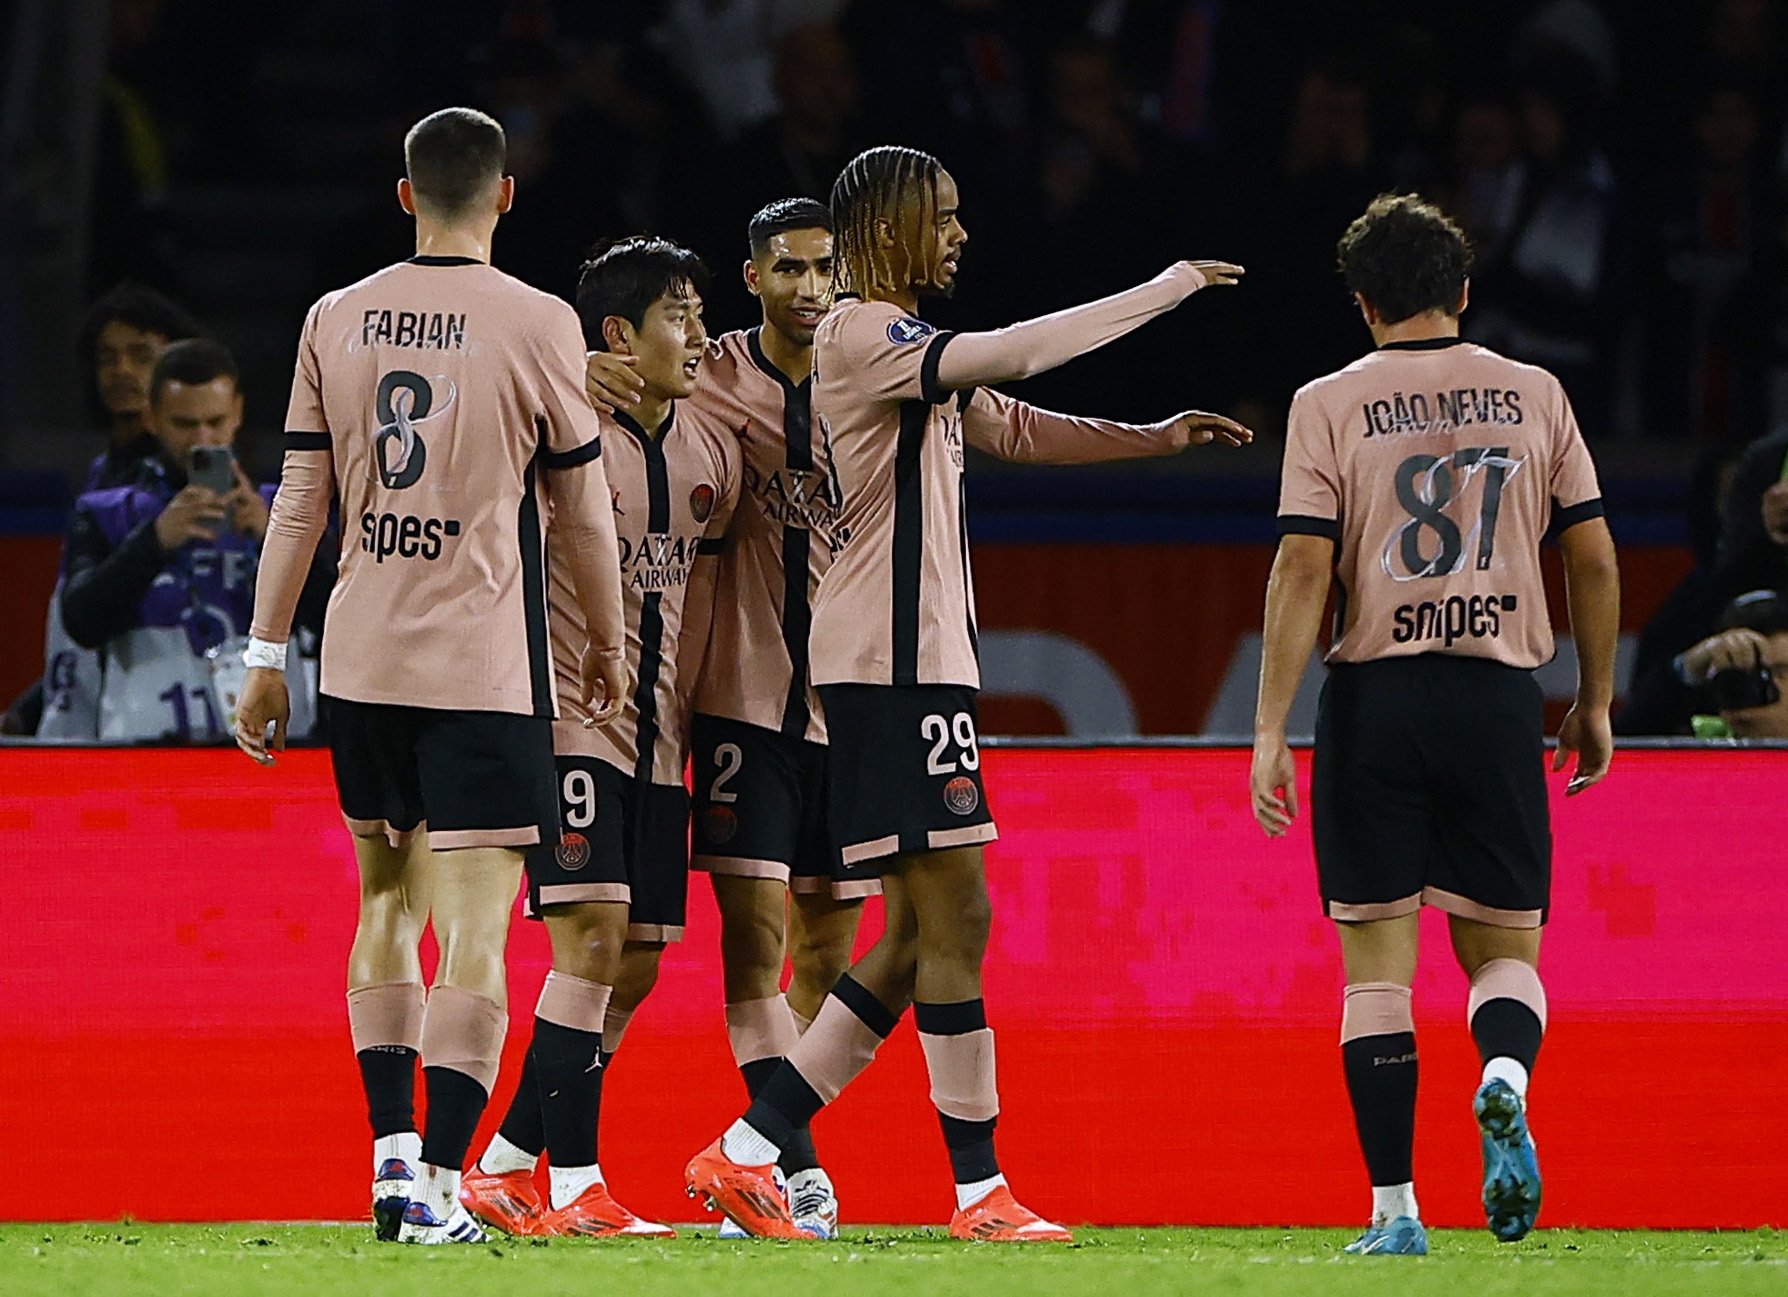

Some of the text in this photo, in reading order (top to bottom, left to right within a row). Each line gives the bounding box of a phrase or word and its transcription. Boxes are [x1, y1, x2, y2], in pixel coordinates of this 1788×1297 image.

[363, 309, 466, 349] FABIAN
[377, 370, 432, 489] 8
[1363, 388, 1523, 438] JOÃO NEVES
[1395, 447, 1509, 578] 87
[1392, 594, 1501, 648] snipes
[710, 743, 742, 803] 2
[921, 712, 979, 776] 29
